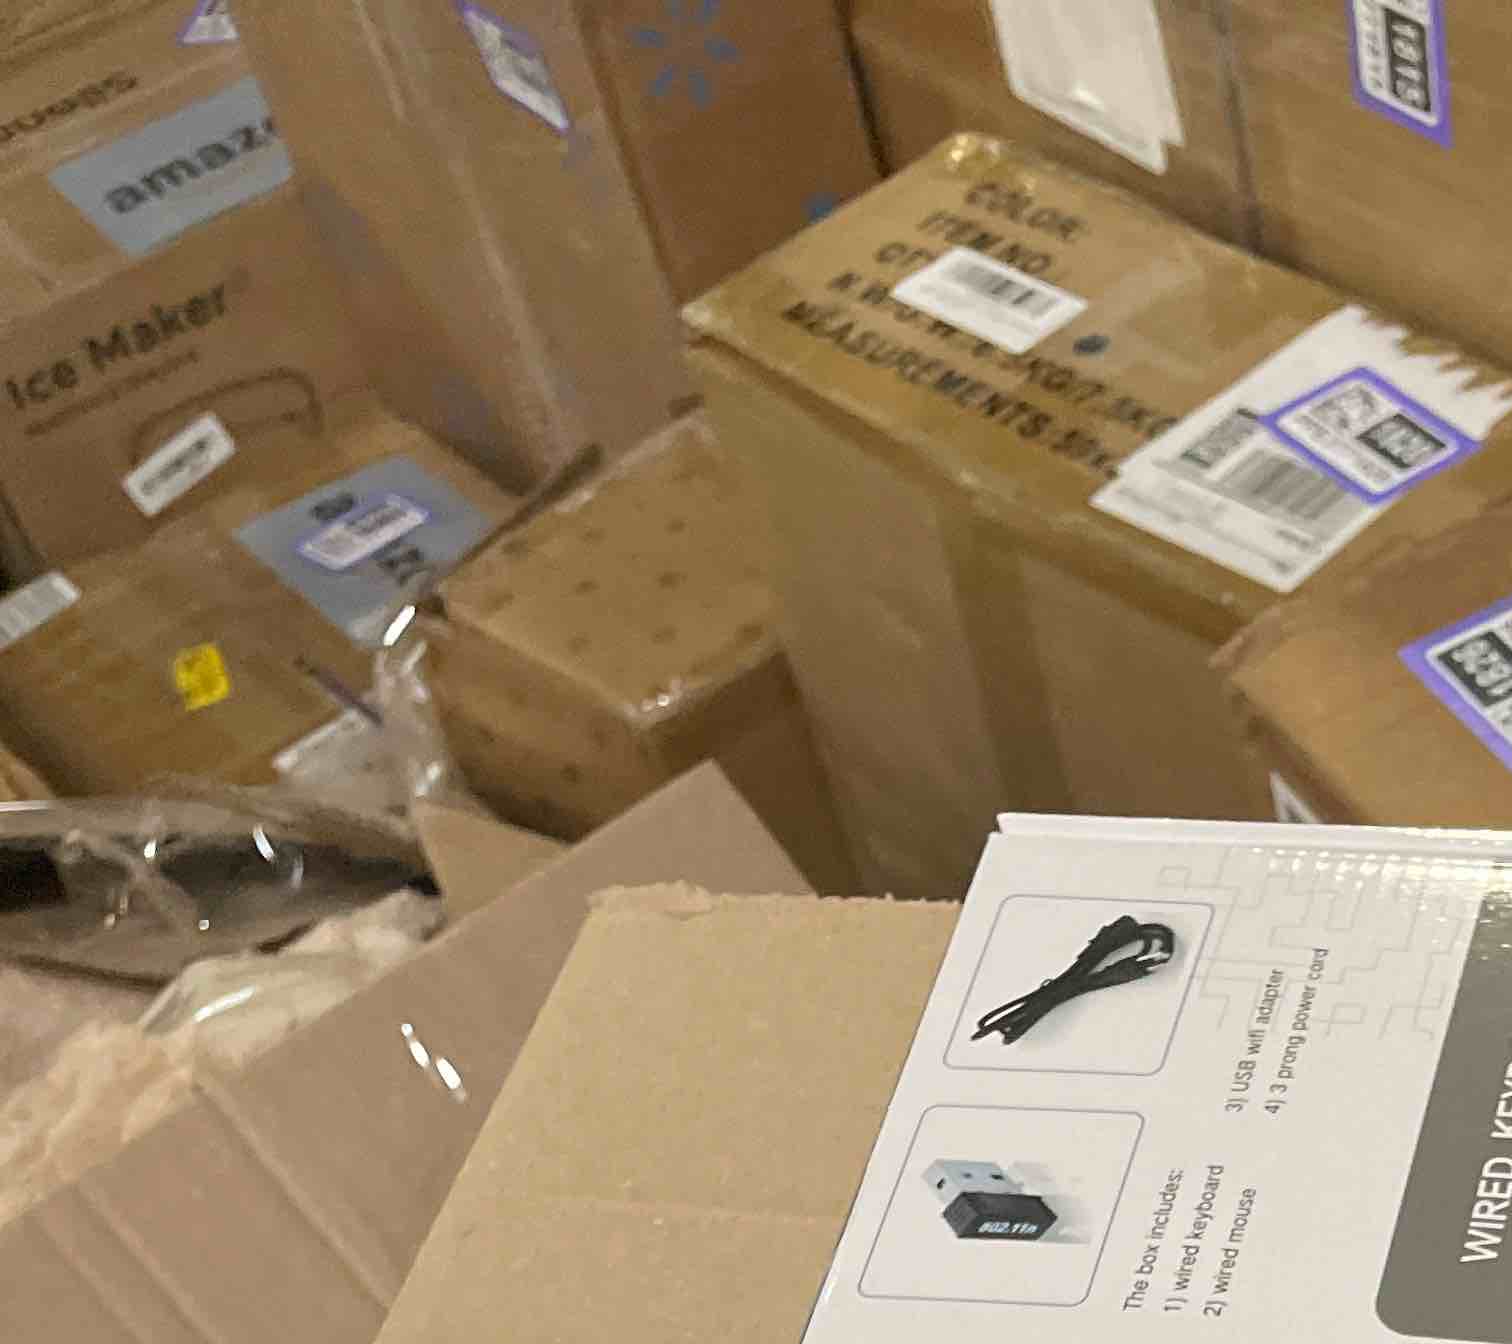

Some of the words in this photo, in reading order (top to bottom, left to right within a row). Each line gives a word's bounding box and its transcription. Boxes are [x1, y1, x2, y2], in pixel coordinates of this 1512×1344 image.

[7, 357, 80, 409] Ice
[84, 282, 226, 371] Maker
[1308, 947, 1331, 981] cord
[1255, 968, 1285, 1025] adapter
[1291, 985, 1318, 1032] power
[1247, 1028, 1267, 1056] wifi
[1277, 1035, 1308, 1080] prong
[1230, 1060, 1257, 1093] USB
[1269, 1084, 1288, 1094] 3
[1224, 1098, 1250, 1113] 3)
[1264, 1099, 1288, 1114] 4)
[1145, 1169, 1185, 1240] includes:
[1184, 1164, 1225, 1240] keyboard
[1228, 1188, 1257, 1243] mouse
[1136, 1243, 1161, 1275] box
[1173, 1244, 1200, 1292] wired
[1212, 1248, 1240, 1295] wired
[1122, 1279, 1150, 1312] The
[1163, 1297, 1189, 1312] 1)
[1202, 1300, 1229, 1318] 2)
